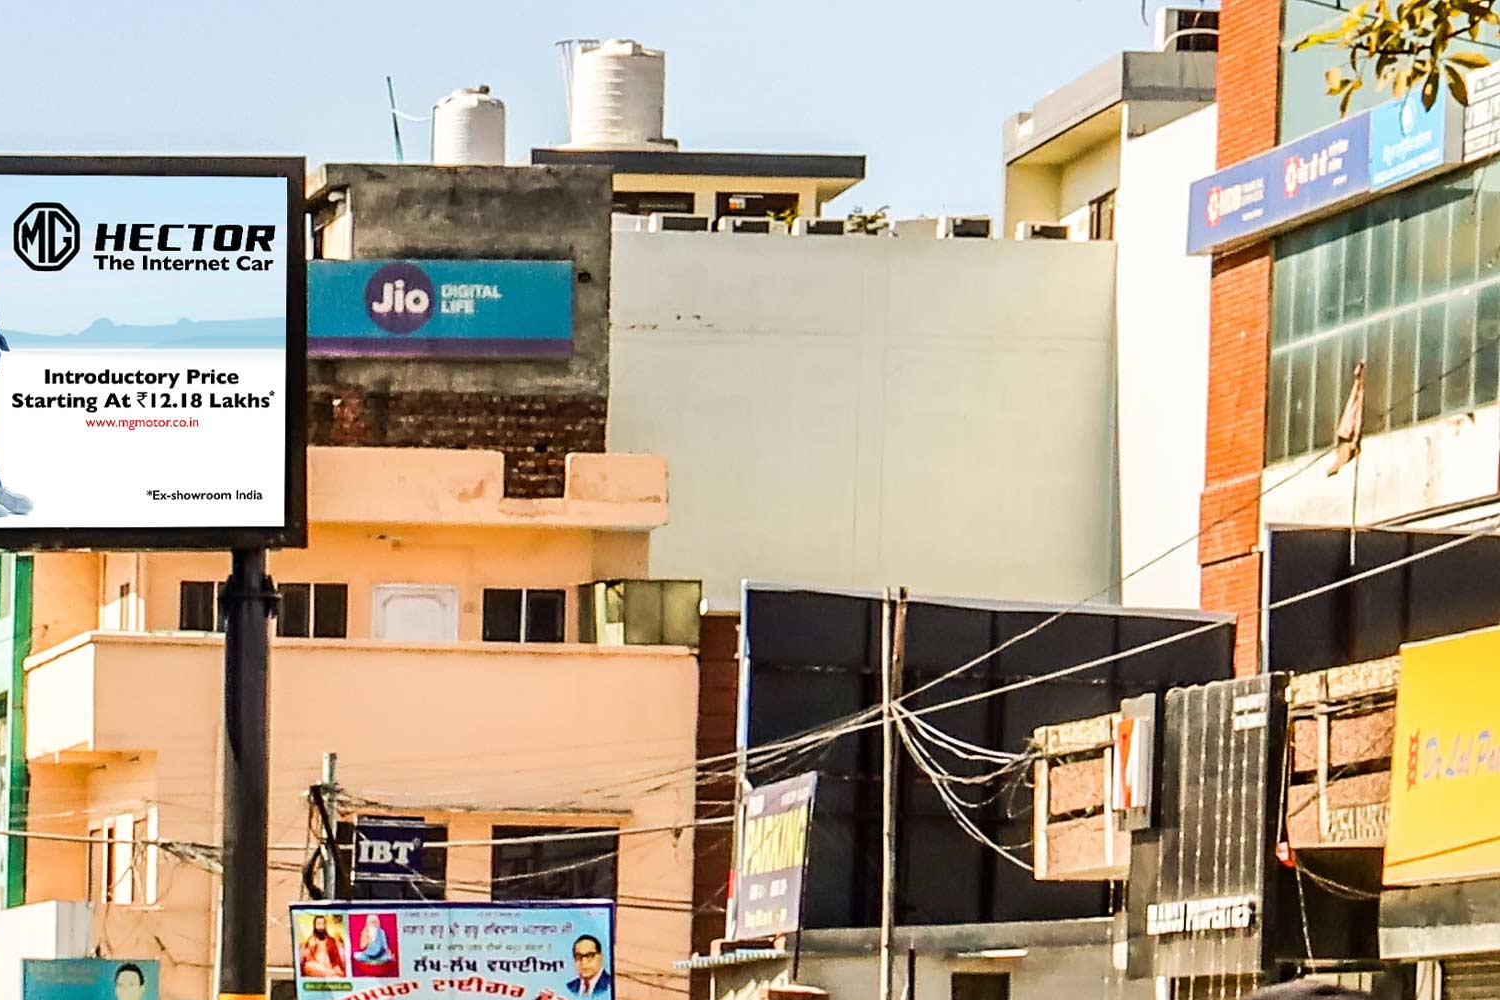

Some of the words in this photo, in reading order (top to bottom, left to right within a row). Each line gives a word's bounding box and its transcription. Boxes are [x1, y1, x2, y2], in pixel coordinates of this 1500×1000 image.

[17, 206, 77, 268] MG
[95, 223, 276, 252] HECTOR
[94, 255, 135, 271] The
[142, 255, 230, 271] Internet
[236, 255, 274, 271] Car
[371, 278, 430, 314] Jio
[441, 284, 502, 299] DIGITAL
[441, 300, 476, 314] LIFE
[44, 369, 180, 389] Introductory
[186, 369, 240, 385] Price
[11, 393, 98, 413] Starting
[104, 393, 132, 409] At
[136, 391, 203, 409] ₹12.18
[85, 417, 200, 431] www.mgmotor.co.in
[235, 489, 264, 501] India
